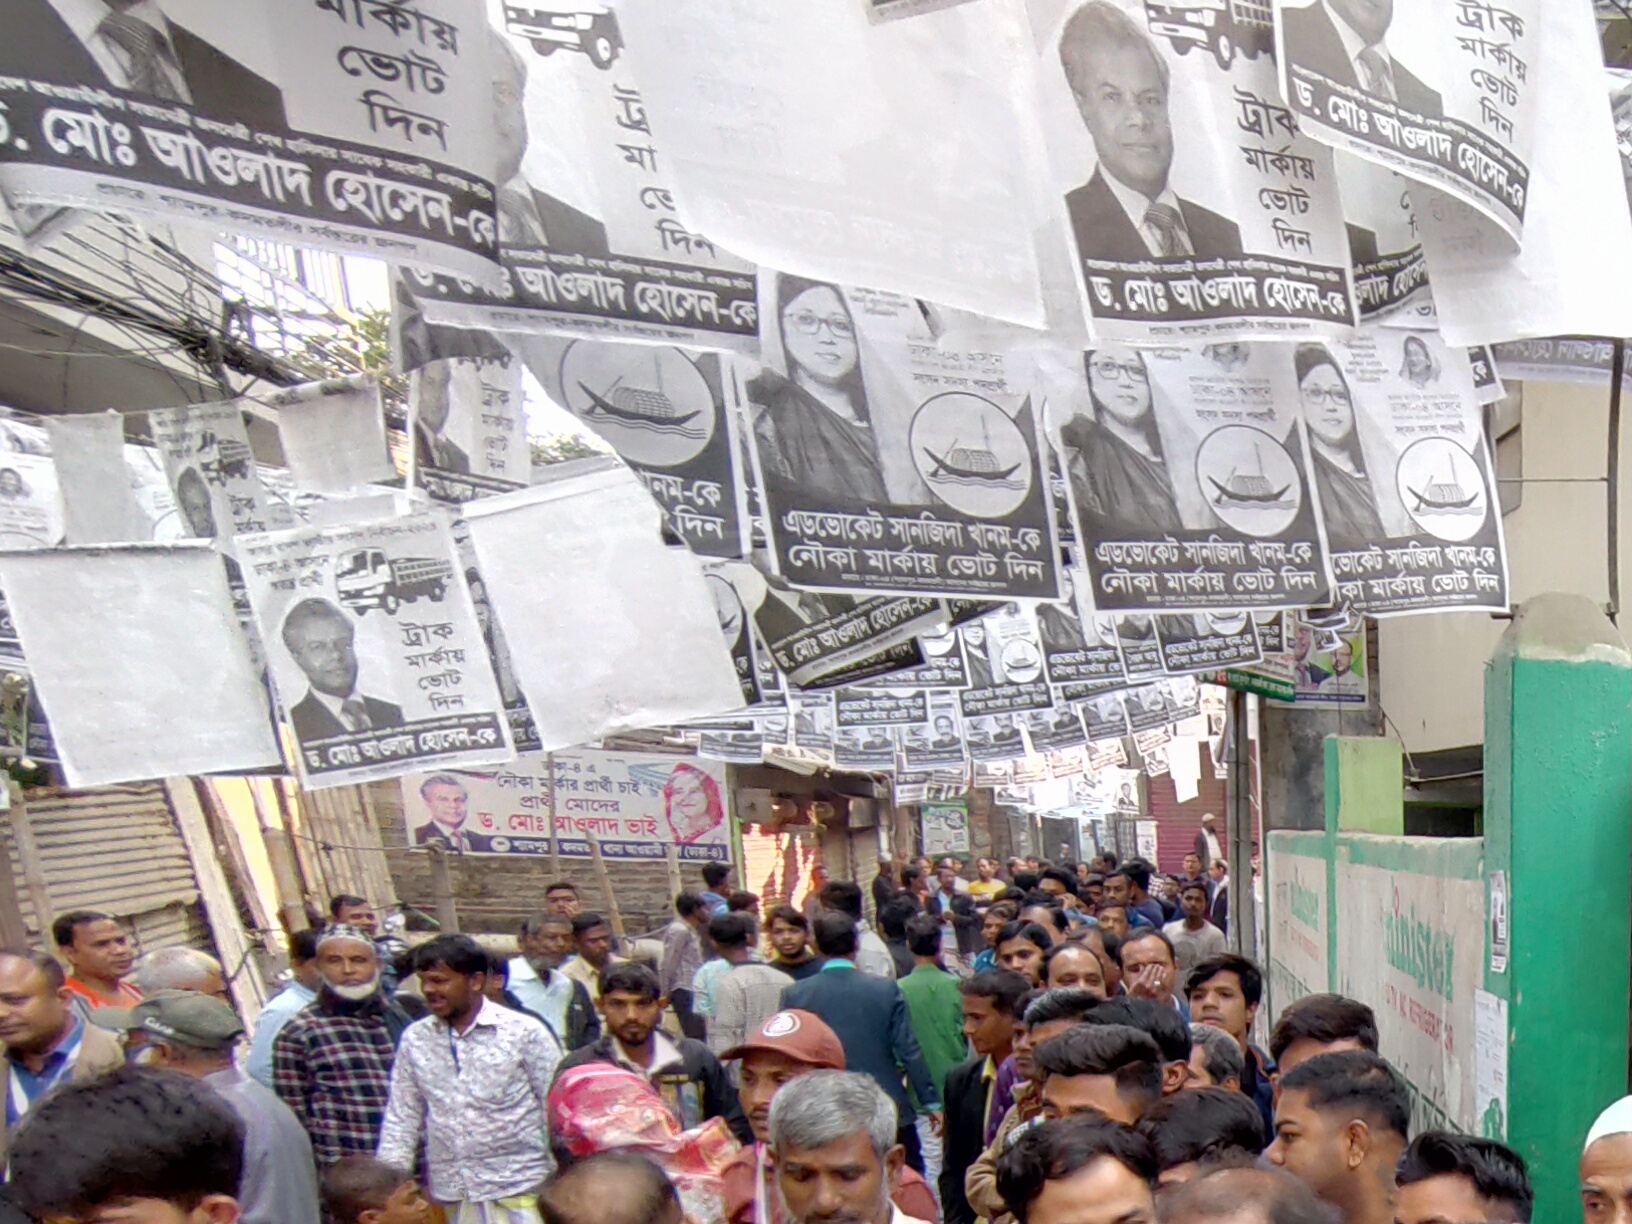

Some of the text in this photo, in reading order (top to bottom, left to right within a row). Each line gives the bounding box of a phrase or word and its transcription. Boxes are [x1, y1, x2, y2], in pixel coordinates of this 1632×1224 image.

[337, 45, 448, 94] ভোট
[1456, 33, 1527, 83] মার্কায়
[1471, 67, 1518, 107] ভোট
[357, 89, 449, 151] দিন
[1233, 84, 1299, 139] ট্রাক
[1480, 98, 1514, 142] দিন
[1293, 78, 1321, 116] ড.
[1328, 95, 1369, 132] মোঃ
[1373, 110, 1452, 162] আওলাদ
[1457, 144, 1524, 208] হোসেন-কে
[42, 108, 138, 166] মোঃ
[140, 125, 314, 206] আওলাদ
[325, 169, 496, 248] হোসেন-কে
[1240, 145, 1315, 181] মার্কায়
[1259, 185, 1311, 214] ভোট
[655, 218, 716, 258] দিন
[1272, 219, 1312, 254] দিন
[515, 260, 625, 312] আওলাদ
[634, 280, 757, 327] হোসেন-কে
[1090, 271, 1346, 316] ড. মোঃ আওলাদ হোসেন-কে
[673, 505, 724, 540] দিন
[782, 507, 1041, 552] এডভোকেট সানজিদা খানম-কে
[789, 537, 1044, 582] নৌকা মার্কায় ভোট দিন
[1095, 532, 1312, 566] এডভোকেট সানজিদা খানম-কে
[1331, 541, 1496, 574] ভোকেট সানজিদা খানম-কে
[1101, 563, 1318, 593] নৌকা মার্কায় ভোট দিন
[1369, 570, 1426, 597] মার্কায়
[1432, 570, 1469, 593] ভোট
[1473, 569, 1500, 592] দিন
[399, 620, 453, 647] ট্রাক
[793, 636, 821, 661] মোঃ
[816, 617, 872, 648] আওলাদ
[404, 647, 465, 668] মার্কায়
[419, 669, 463, 690] ভোট
[428, 693, 464, 711] দিন
[329, 744, 361, 766] মোঃ
[362, 734, 416, 761] আওলাদ
[498, 771, 534, 789] নৌকা
[565, 797, 621, 813] মোদের
[476, 812, 500, 830] ড.
[508, 813, 545, 832] মোঃ
[624, 813, 660, 836] ভাই
